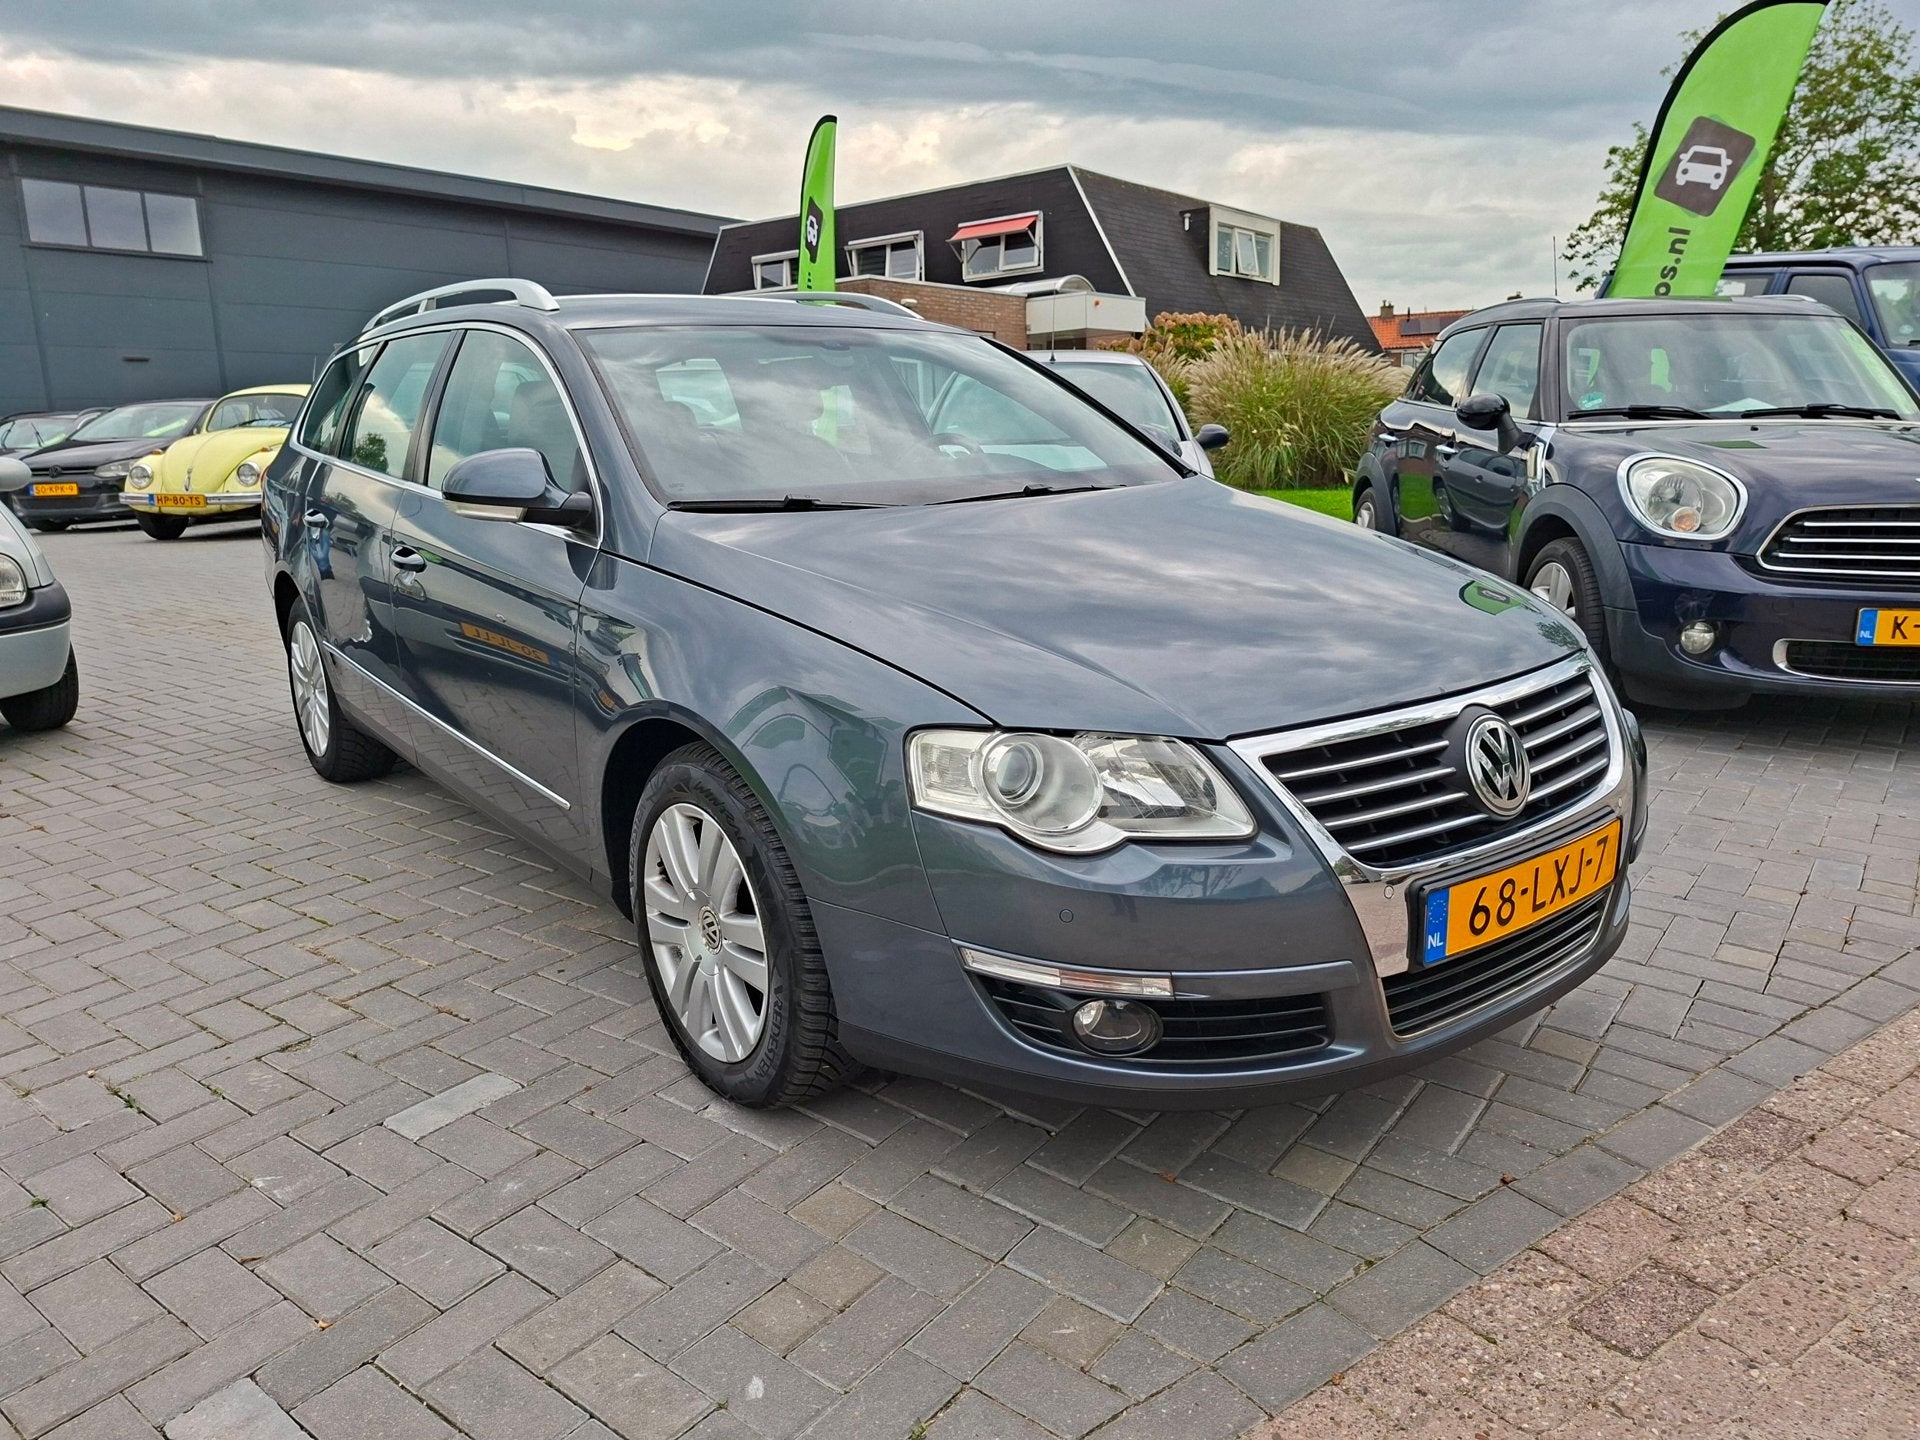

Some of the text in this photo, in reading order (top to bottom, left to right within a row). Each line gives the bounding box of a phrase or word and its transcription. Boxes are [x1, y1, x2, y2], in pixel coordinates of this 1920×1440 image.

[157, 496, 201, 506] HP-80-TS
[1860, 630, 1873, 639] NL
[1468, 834, 1609, 937] 68-LXJ-7
[1427, 931, 1444, 950] NL
[754, 984, 784, 1078] VREDESTEIN
